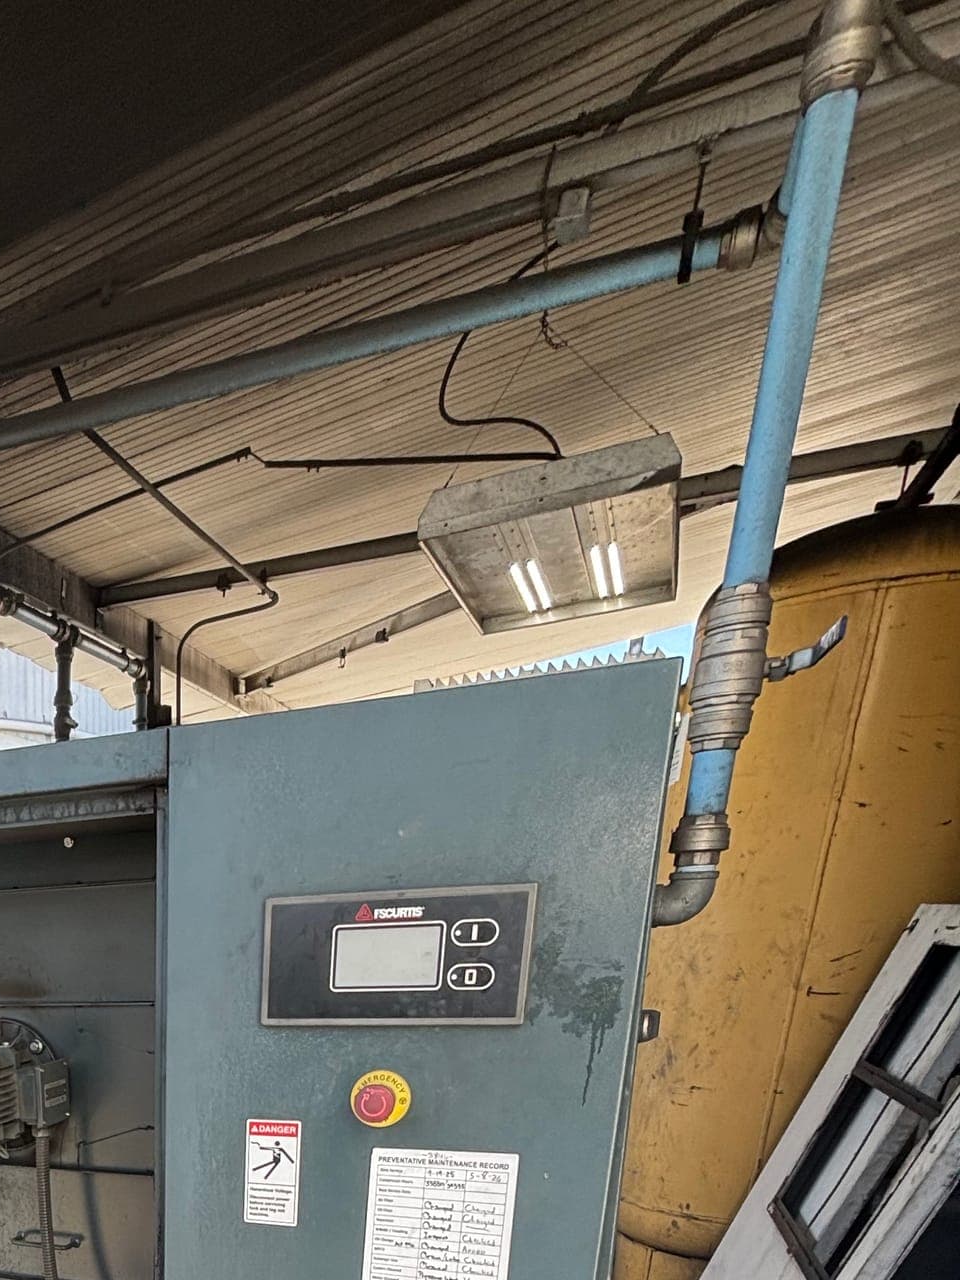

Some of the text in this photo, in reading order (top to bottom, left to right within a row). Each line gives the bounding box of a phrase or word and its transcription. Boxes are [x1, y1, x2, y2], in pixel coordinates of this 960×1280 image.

[258, 1125, 297, 1134] DANGER
[378, 1156, 509, 1170] PREVENTATIVE MAINTENANCE RECORD
